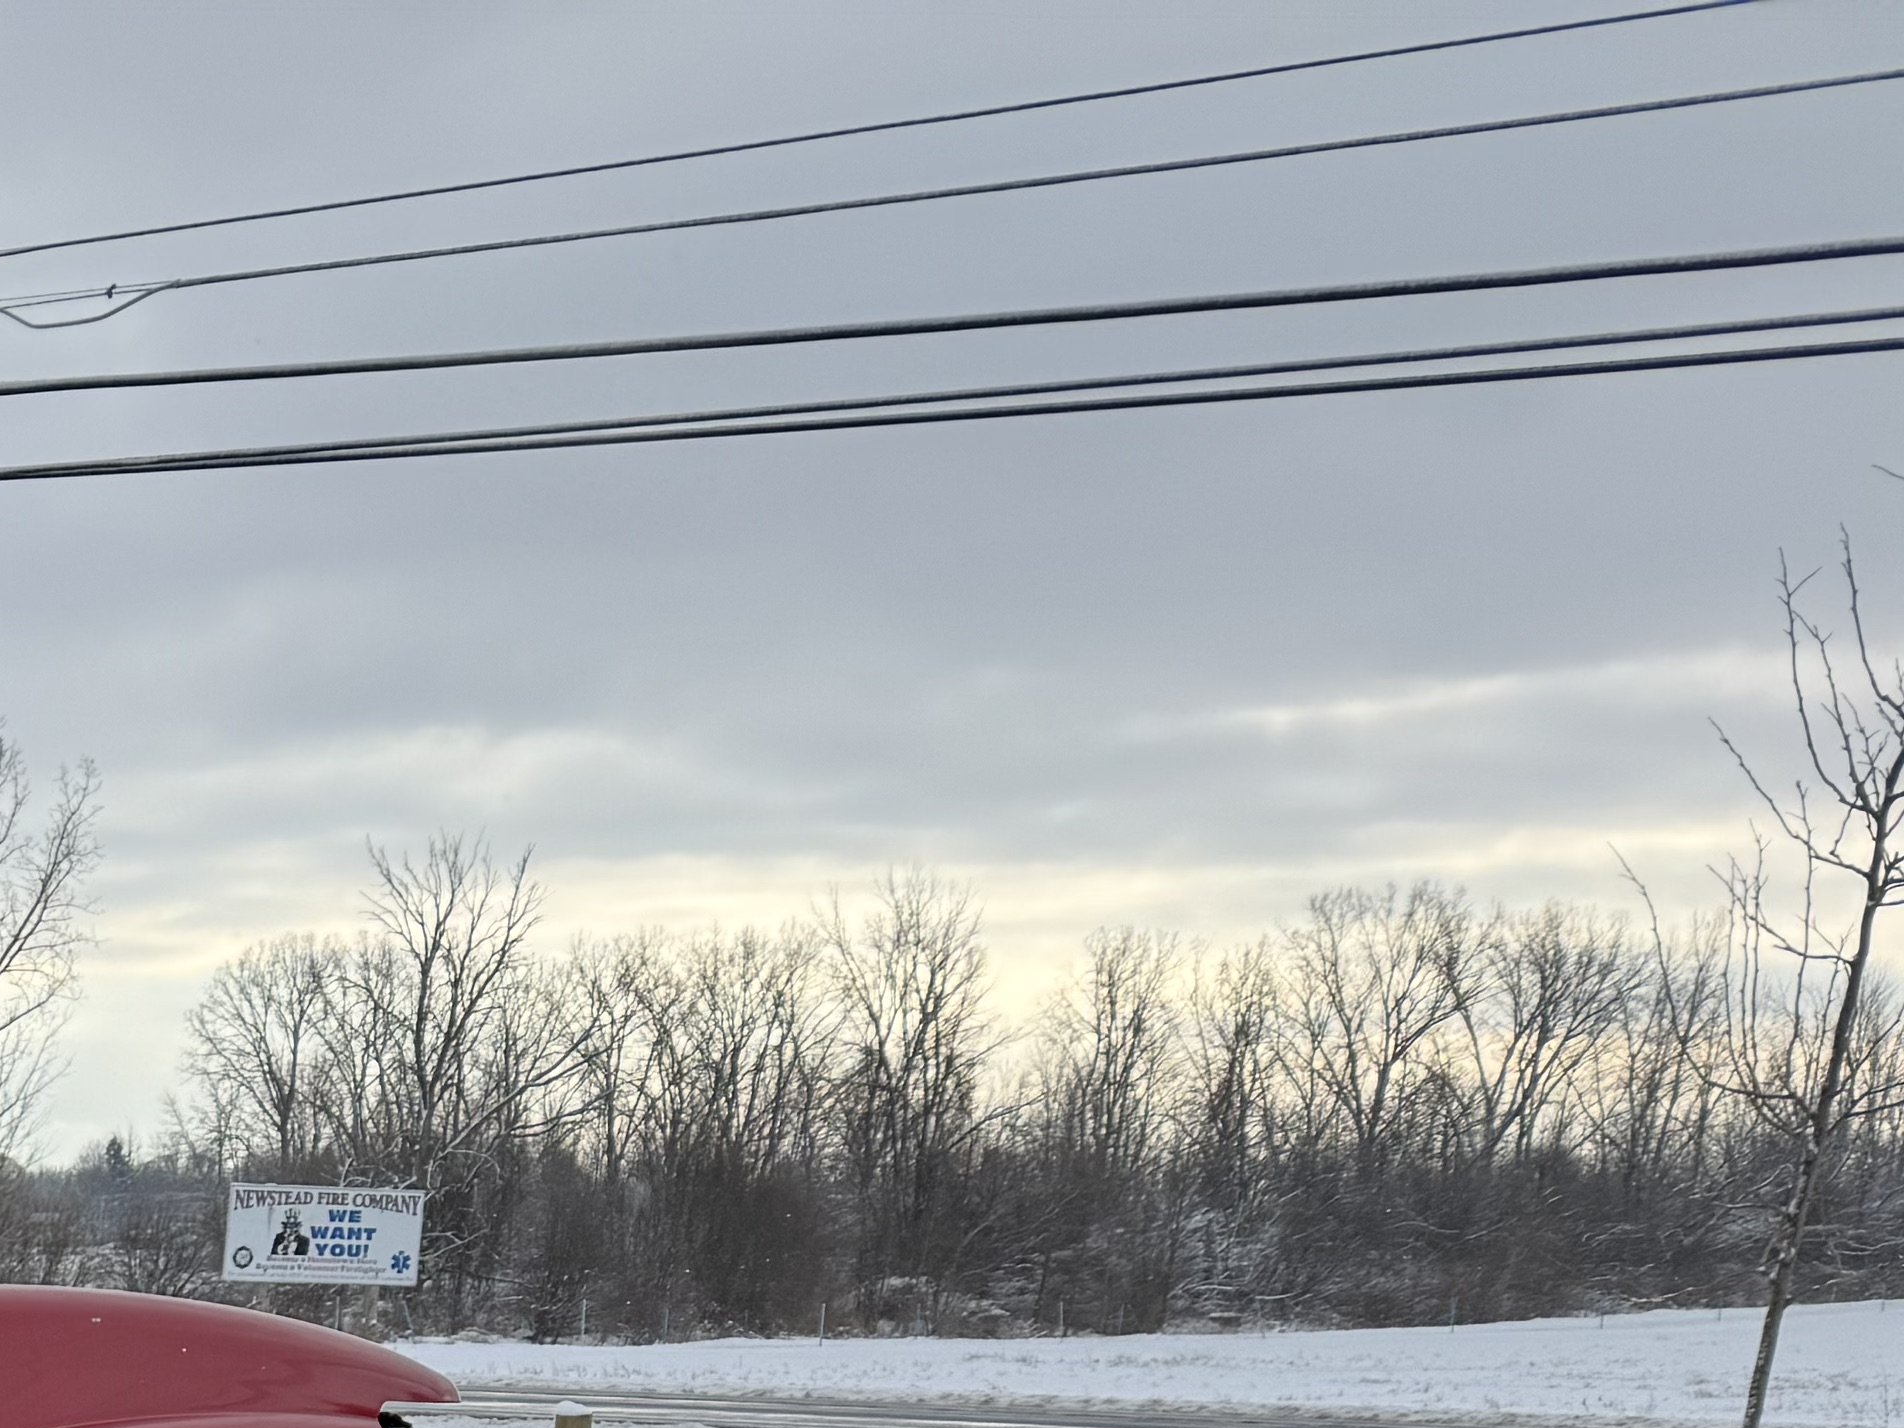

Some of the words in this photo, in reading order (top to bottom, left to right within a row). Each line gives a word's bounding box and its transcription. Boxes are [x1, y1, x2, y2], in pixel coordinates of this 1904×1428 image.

[233, 1189, 314, 1211] NEWSTEAD
[317, 1192, 349, 1206] FIRE
[352, 1193, 421, 1216] COMPANY
[328, 1209, 362, 1223] WE
[310, 1226, 377, 1241] WANT
[314, 1243, 369, 1258] YOU!
